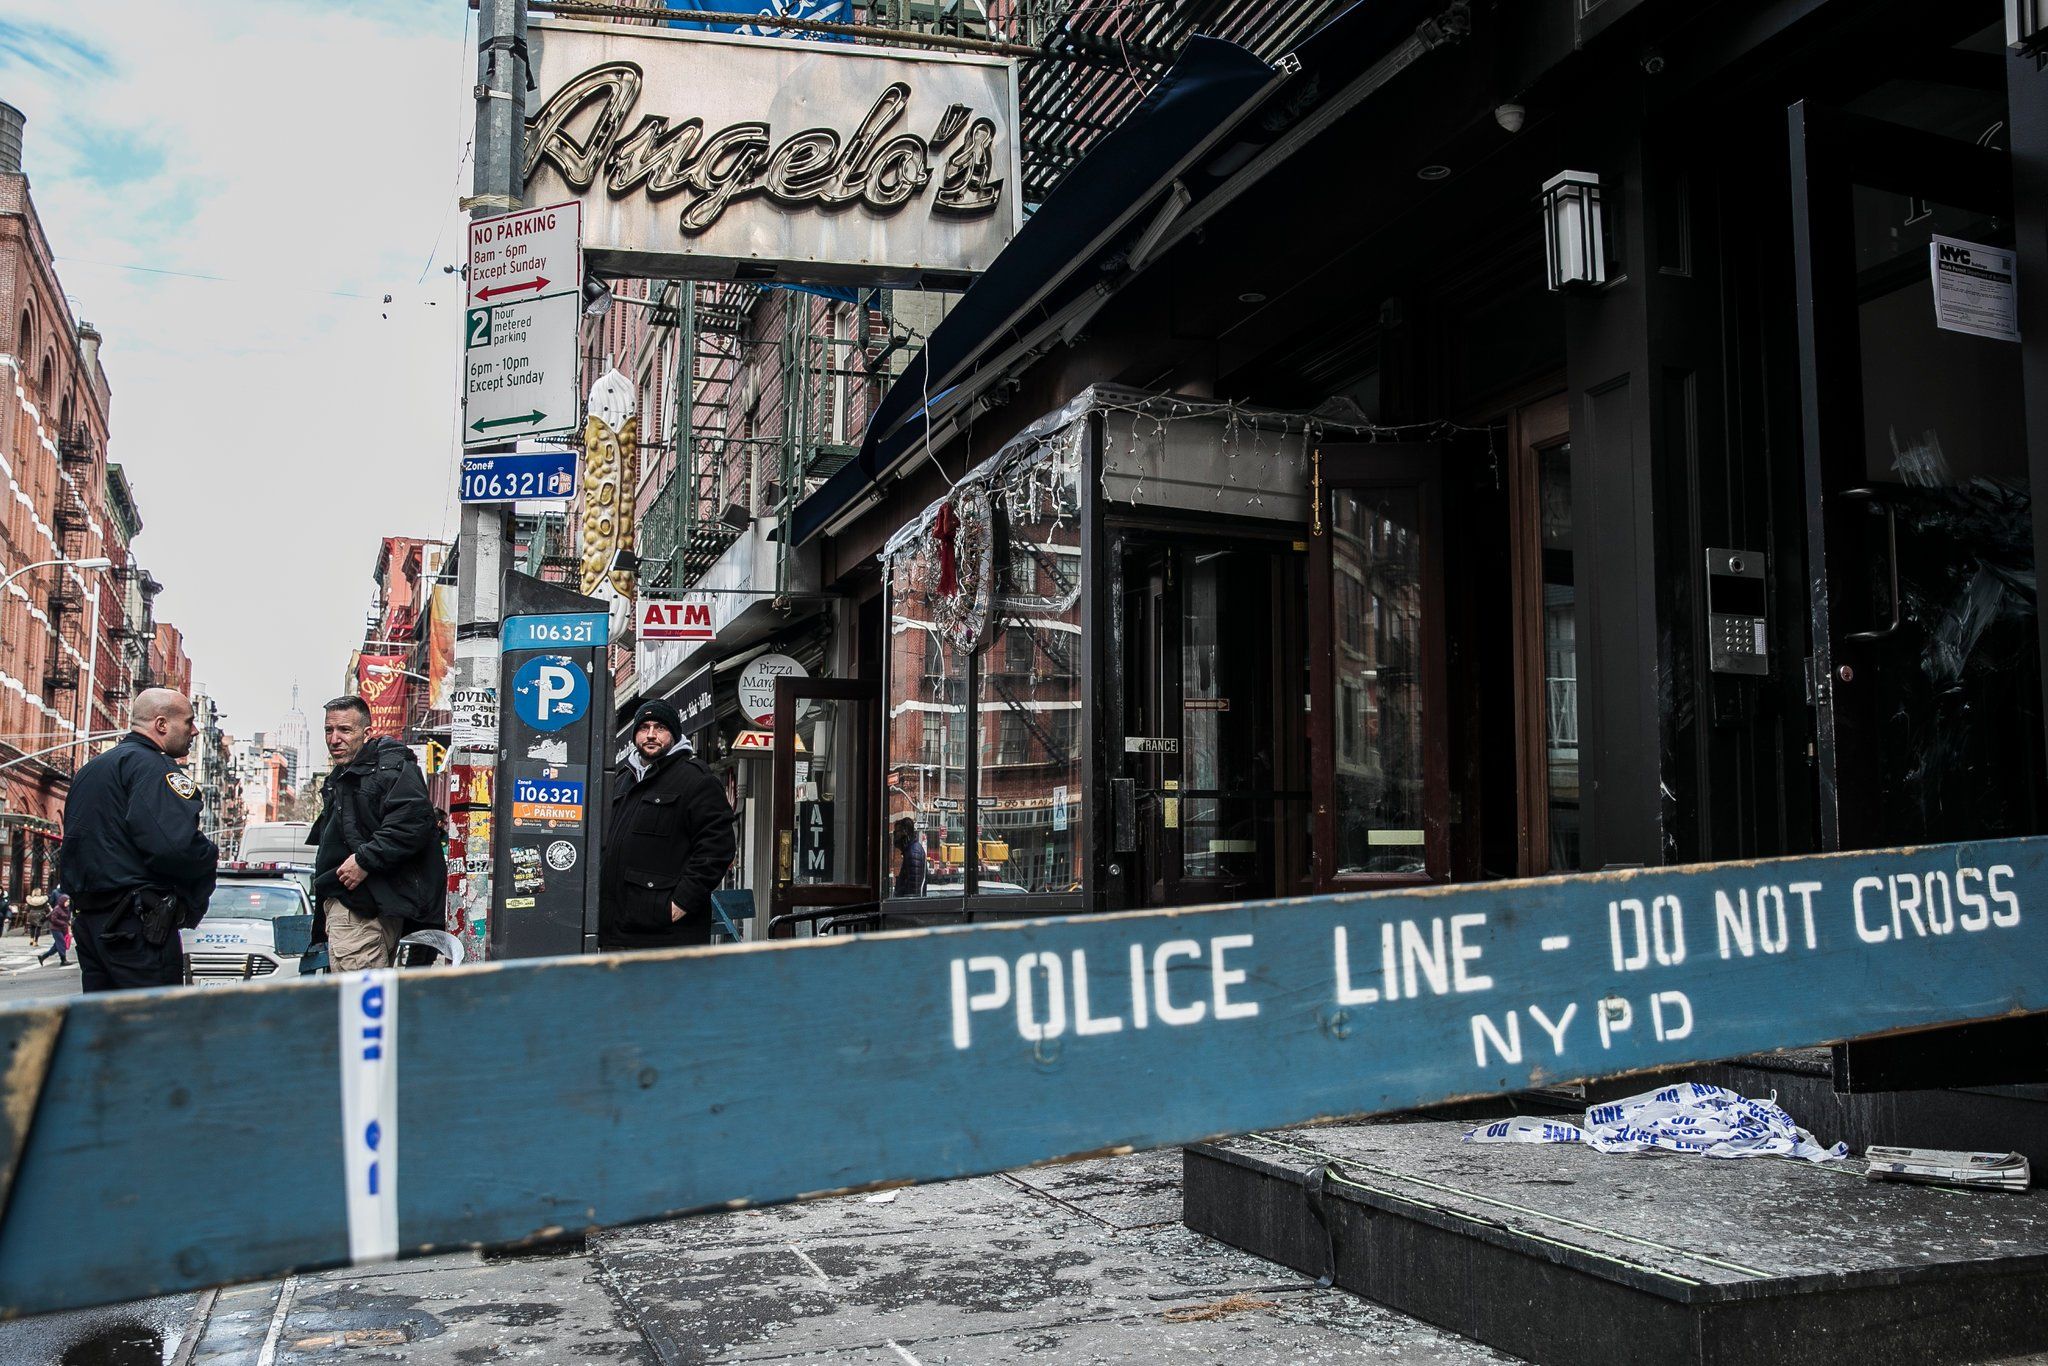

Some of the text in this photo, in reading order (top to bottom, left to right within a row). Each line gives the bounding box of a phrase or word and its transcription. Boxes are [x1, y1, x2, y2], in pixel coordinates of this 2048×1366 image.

[524, 61, 1004, 235] Angelo's
[474, 214, 556, 245] NO PARKING
[474, 249, 495, 264] 8am
[505, 244, 527, 259] 6pm
[1939, 244, 1971, 265] NYC
[473, 257, 546, 280] Except Sunday
[494, 309, 514, 320] hour
[494, 316, 532, 332] metered
[471, 310, 489, 346] 2
[494, 331, 526, 347] parking
[470, 362, 492, 377] 6pm
[502, 356, 529, 371] 10pm
[470, 371, 544, 393] Except Sunday
[466, 460, 494, 471] Zone#
[465, 472, 544, 497] 106321
[643, 604, 711, 626] ATM
[529, 624, 591, 641] 106321
[759, 662, 793, 675] Pizza
[538, 666, 575, 720] P
[743, 676, 775, 693] Marg
[450, 691, 496, 703] MOVIN
[741, 734, 775, 746] AT
[1138, 740, 1176, 752] TRANCE
[520, 786, 578, 803] 106321
[534, 808, 576, 819] PARKNYC
[808, 804, 825, 870] ATM
[950, 864, 2021, 1050] POLICE LINE - DO NOT CROSS
[1470, 990, 1695, 1068] NYPD
[1590, 1105, 1624, 1125] LINE
[1656, 1088, 1681, 1104] DO
[1487, 1122, 1510, 1138] DO
[1543, 1124, 1580, 1142] LINE
